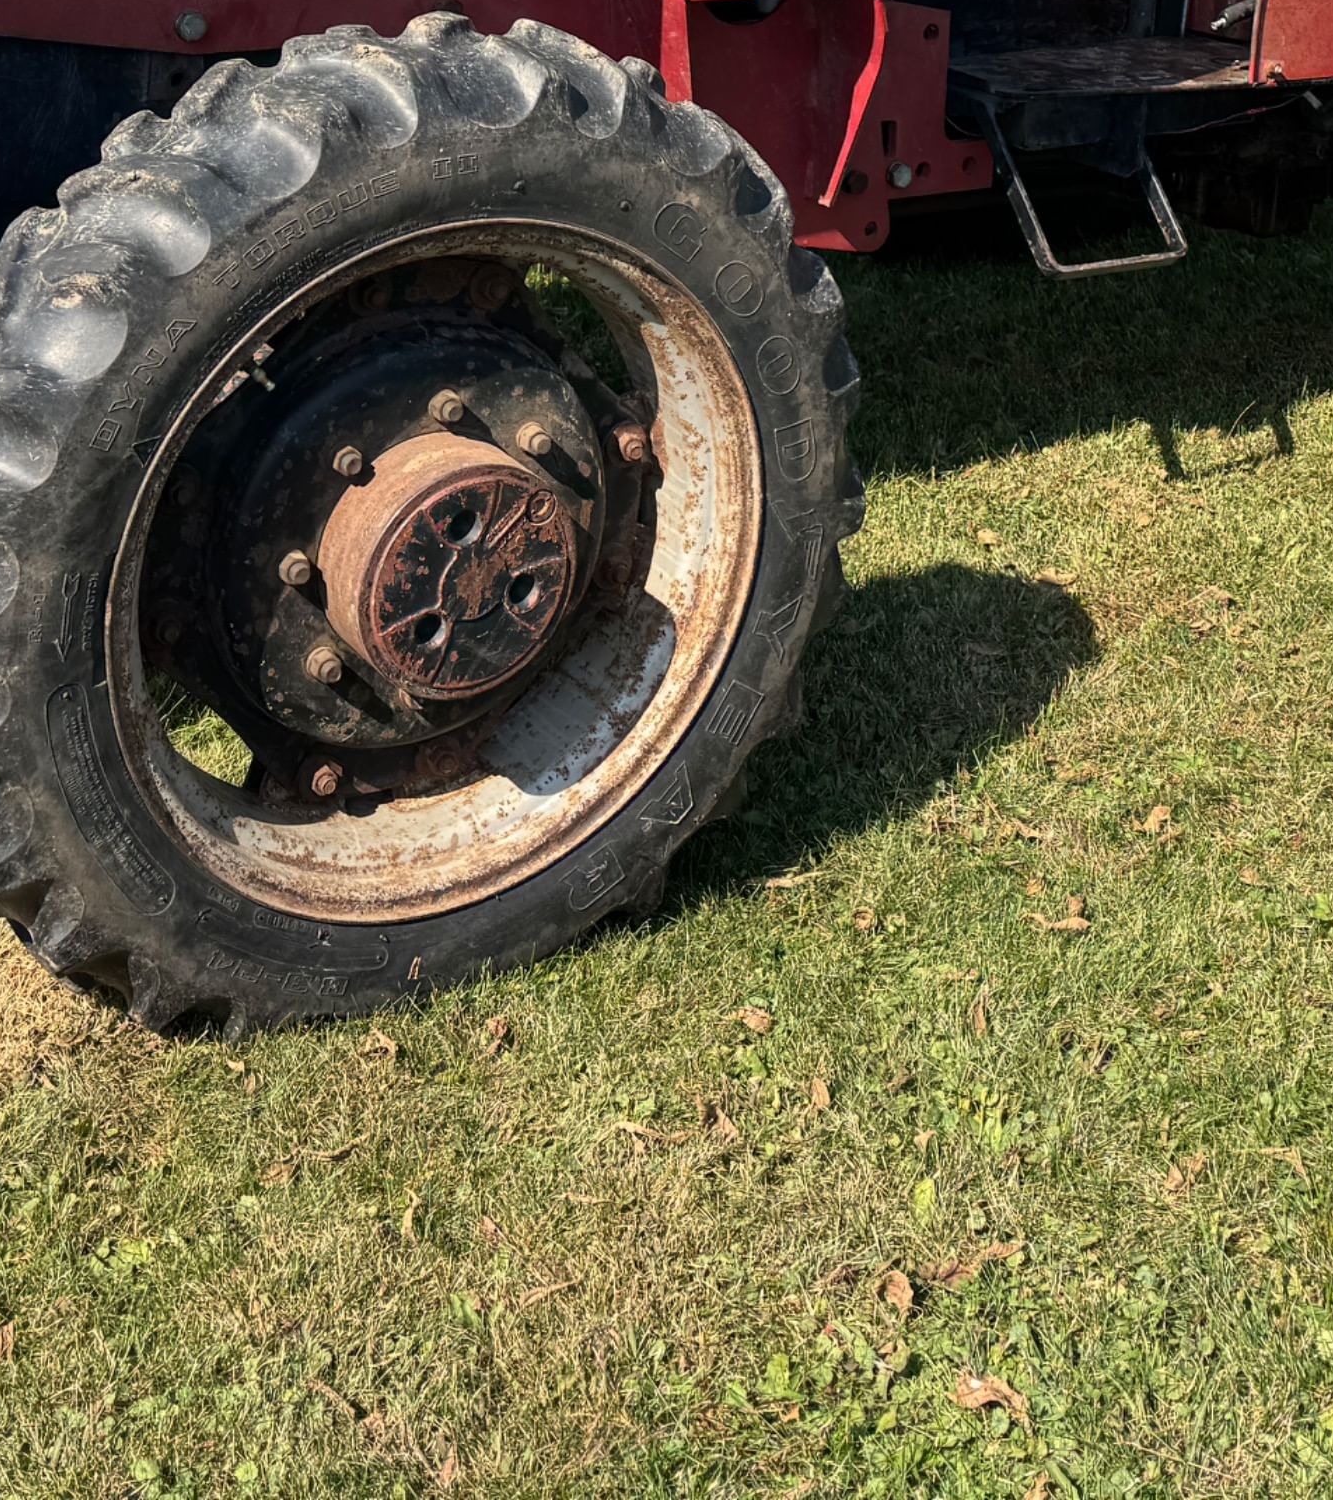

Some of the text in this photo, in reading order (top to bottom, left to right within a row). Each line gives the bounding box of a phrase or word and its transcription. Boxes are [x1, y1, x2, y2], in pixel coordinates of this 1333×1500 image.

[89, 153, 479, 452] DYNA TORQUE II
[567, 200, 821, 910] GOODYEAR
